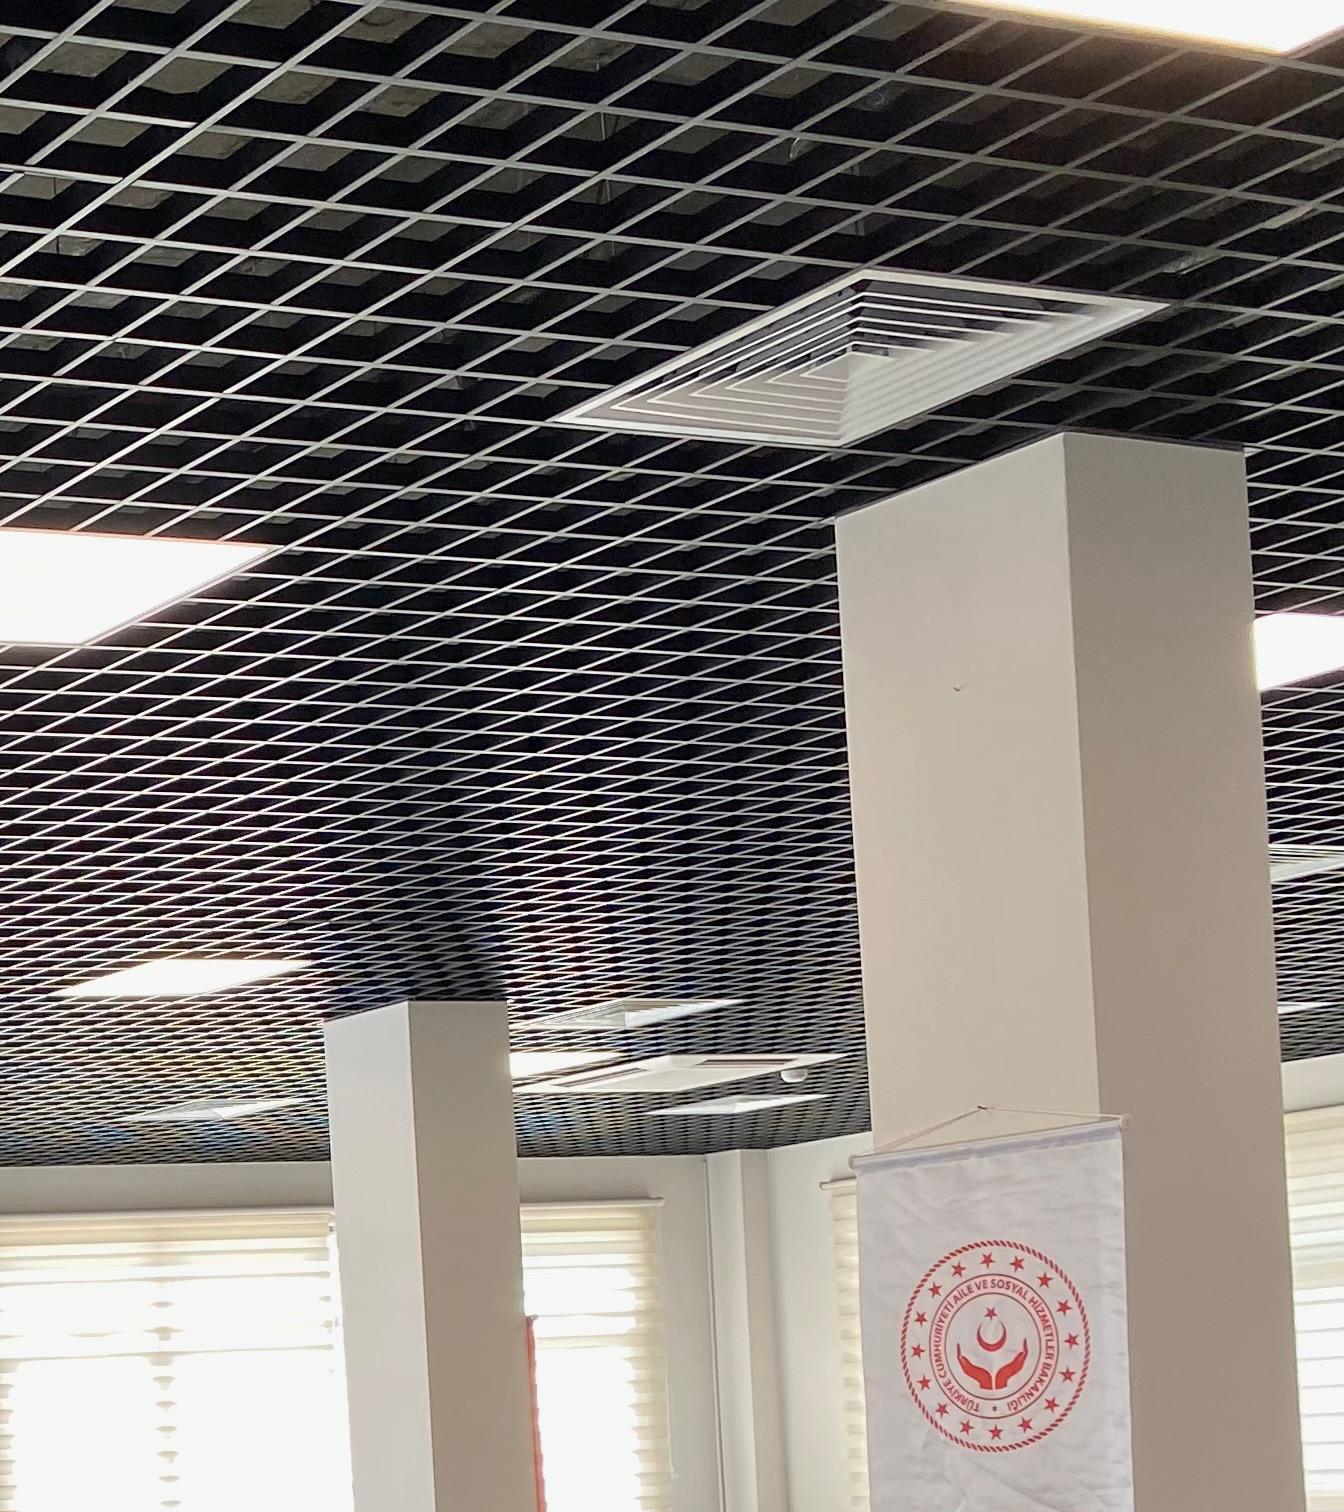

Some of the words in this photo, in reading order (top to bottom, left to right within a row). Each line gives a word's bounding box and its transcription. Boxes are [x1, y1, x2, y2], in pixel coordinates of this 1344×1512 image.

[952, 1284, 974, 1305] AİLE
[975, 1279, 989, 1291] VE
[990, 1278, 1029, 1301] SOSYAL
[930, 1301, 955, 1378] CUMHURİYETİ
[1029, 1296, 1056, 1360] HİZMETLER
[943, 1379, 980, 1413] TÜRKİYE
[1007, 1361, 1054, 1413] BAKANLIĞI
